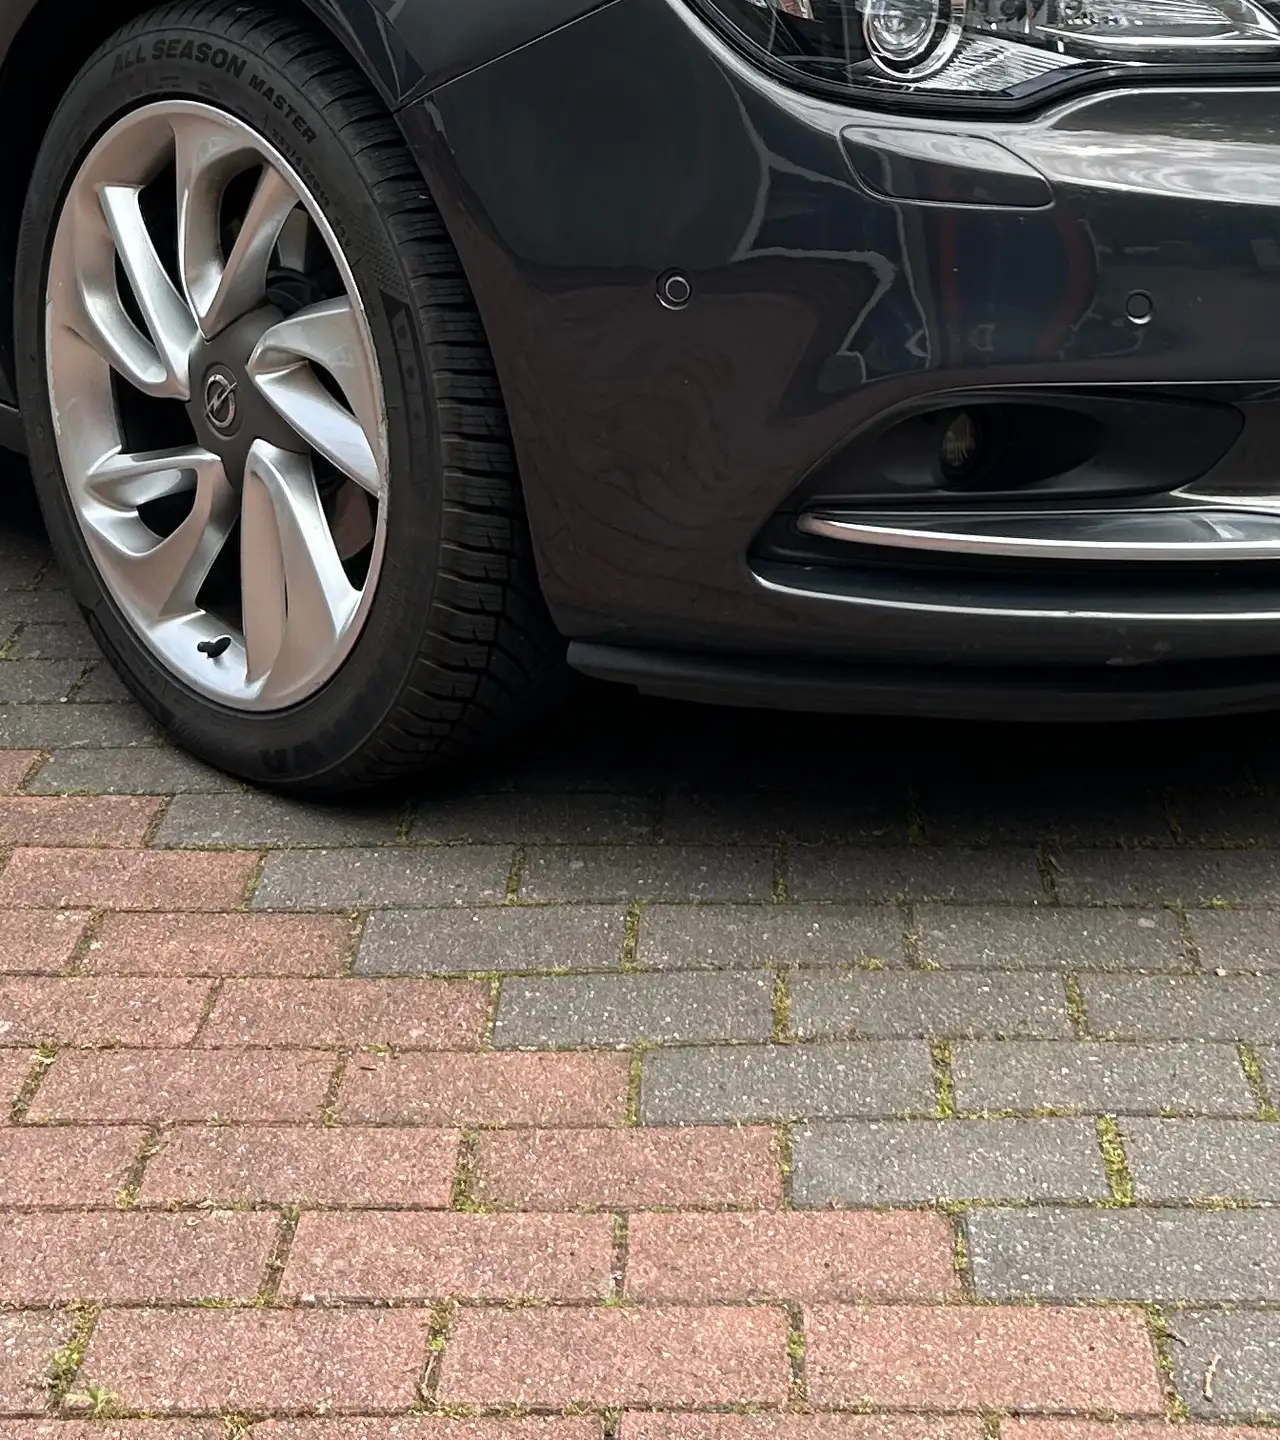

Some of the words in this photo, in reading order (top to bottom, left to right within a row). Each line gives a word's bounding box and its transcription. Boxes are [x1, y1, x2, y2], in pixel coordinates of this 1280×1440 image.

[110, 43, 147, 77] ALL
[151, 38, 248, 79] SEASON
[248, 73, 317, 145] MASTER
